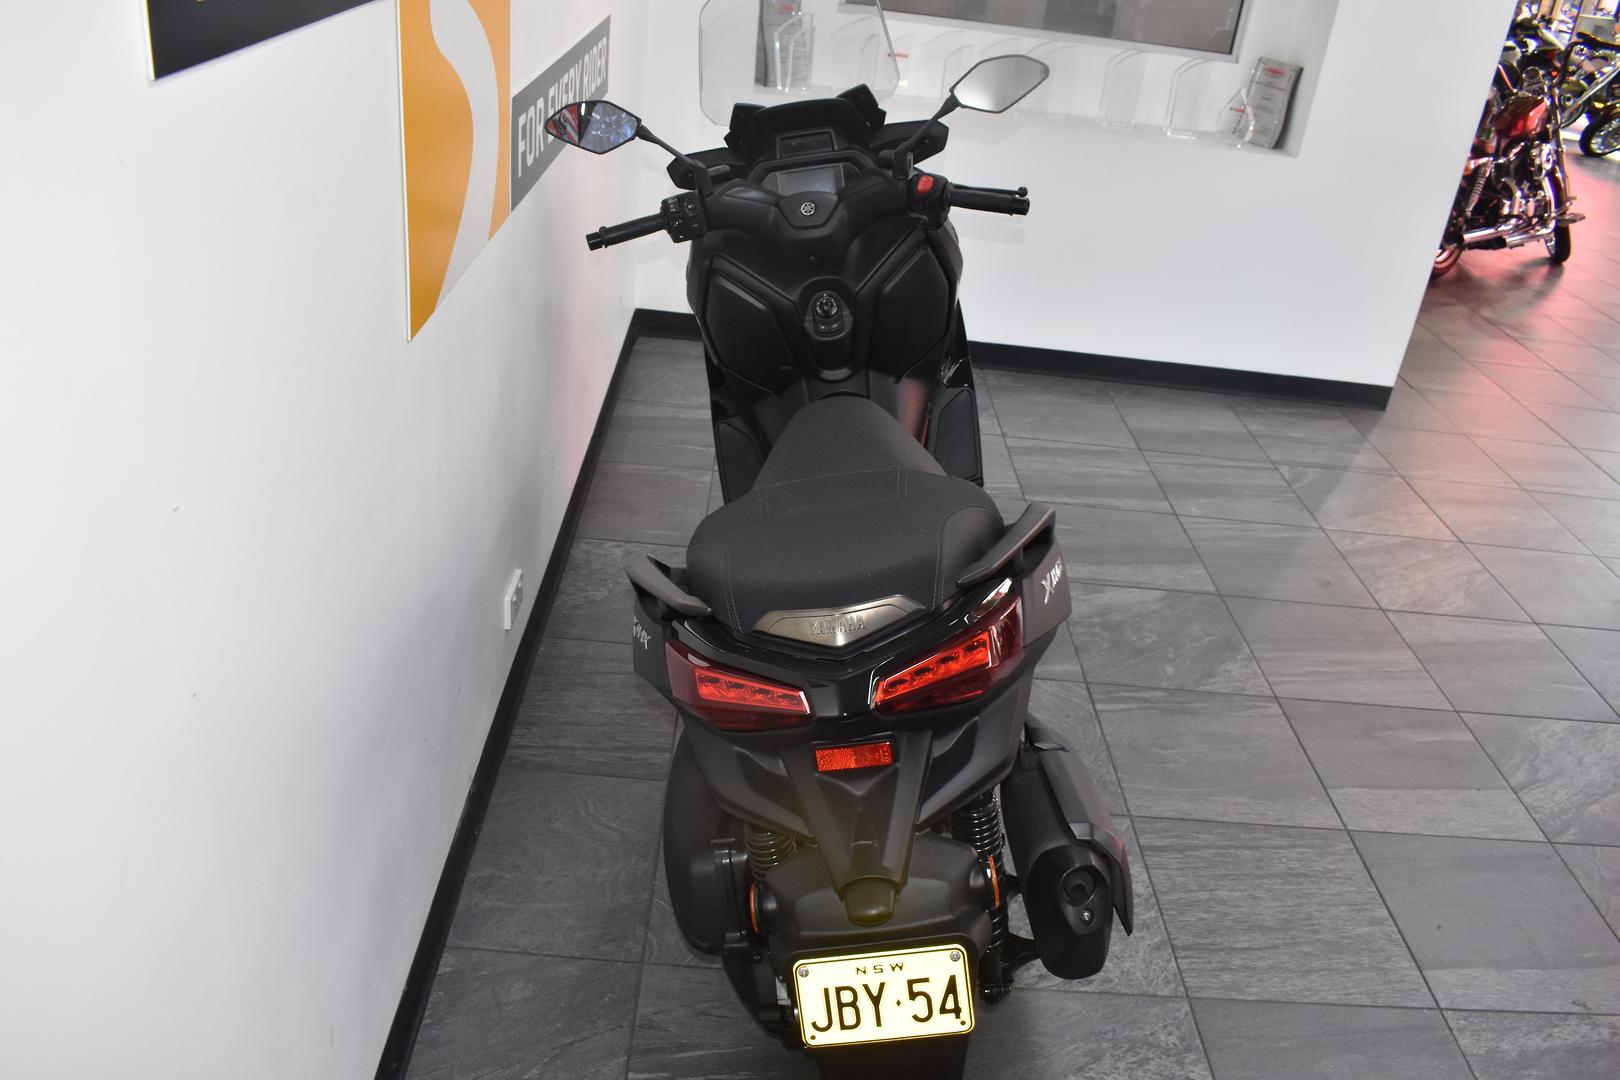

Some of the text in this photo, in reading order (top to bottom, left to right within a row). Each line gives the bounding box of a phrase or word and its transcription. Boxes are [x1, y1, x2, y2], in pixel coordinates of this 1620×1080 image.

[518, 97, 545, 178] FOR
[583, 36, 607, 102] RIDER
[809, 615, 865, 636] YAMAHA
[856, 962, 904, 975] NSW
